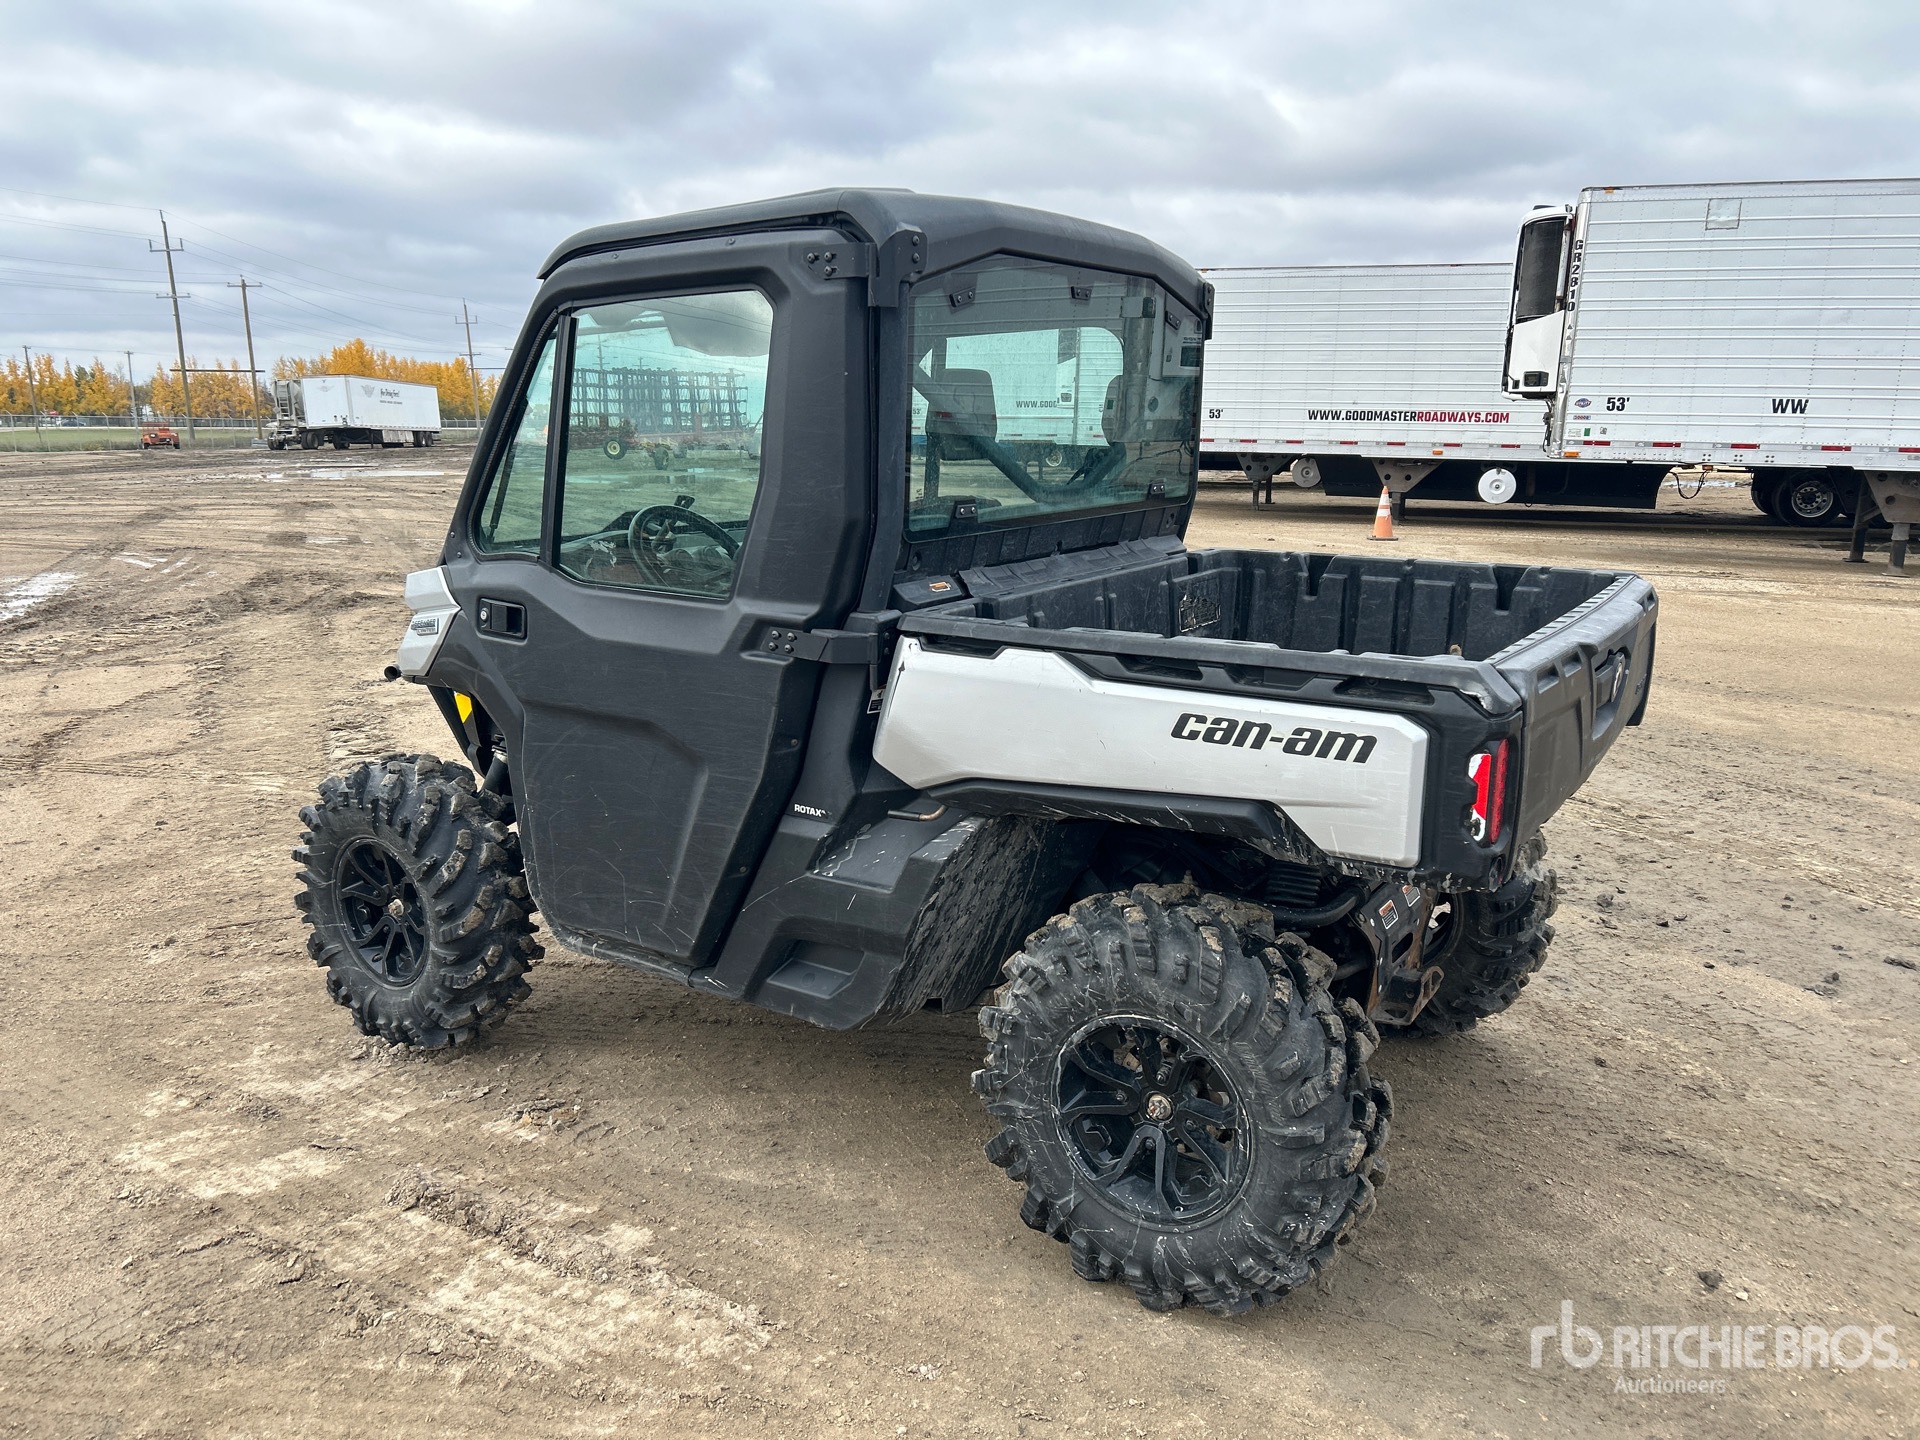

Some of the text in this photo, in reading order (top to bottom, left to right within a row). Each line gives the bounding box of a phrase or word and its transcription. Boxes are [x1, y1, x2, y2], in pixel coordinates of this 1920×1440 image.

[1567, 240, 1583, 311] GR2810
[1606, 397, 1630, 411] 53'
[1772, 398, 1809, 414] WW
[1209, 409, 1223, 419] 53'
[1308, 410, 1510, 423] WWW.GOODMASTERROADWAYS.COM
[1170, 712, 1378, 763] can-am
